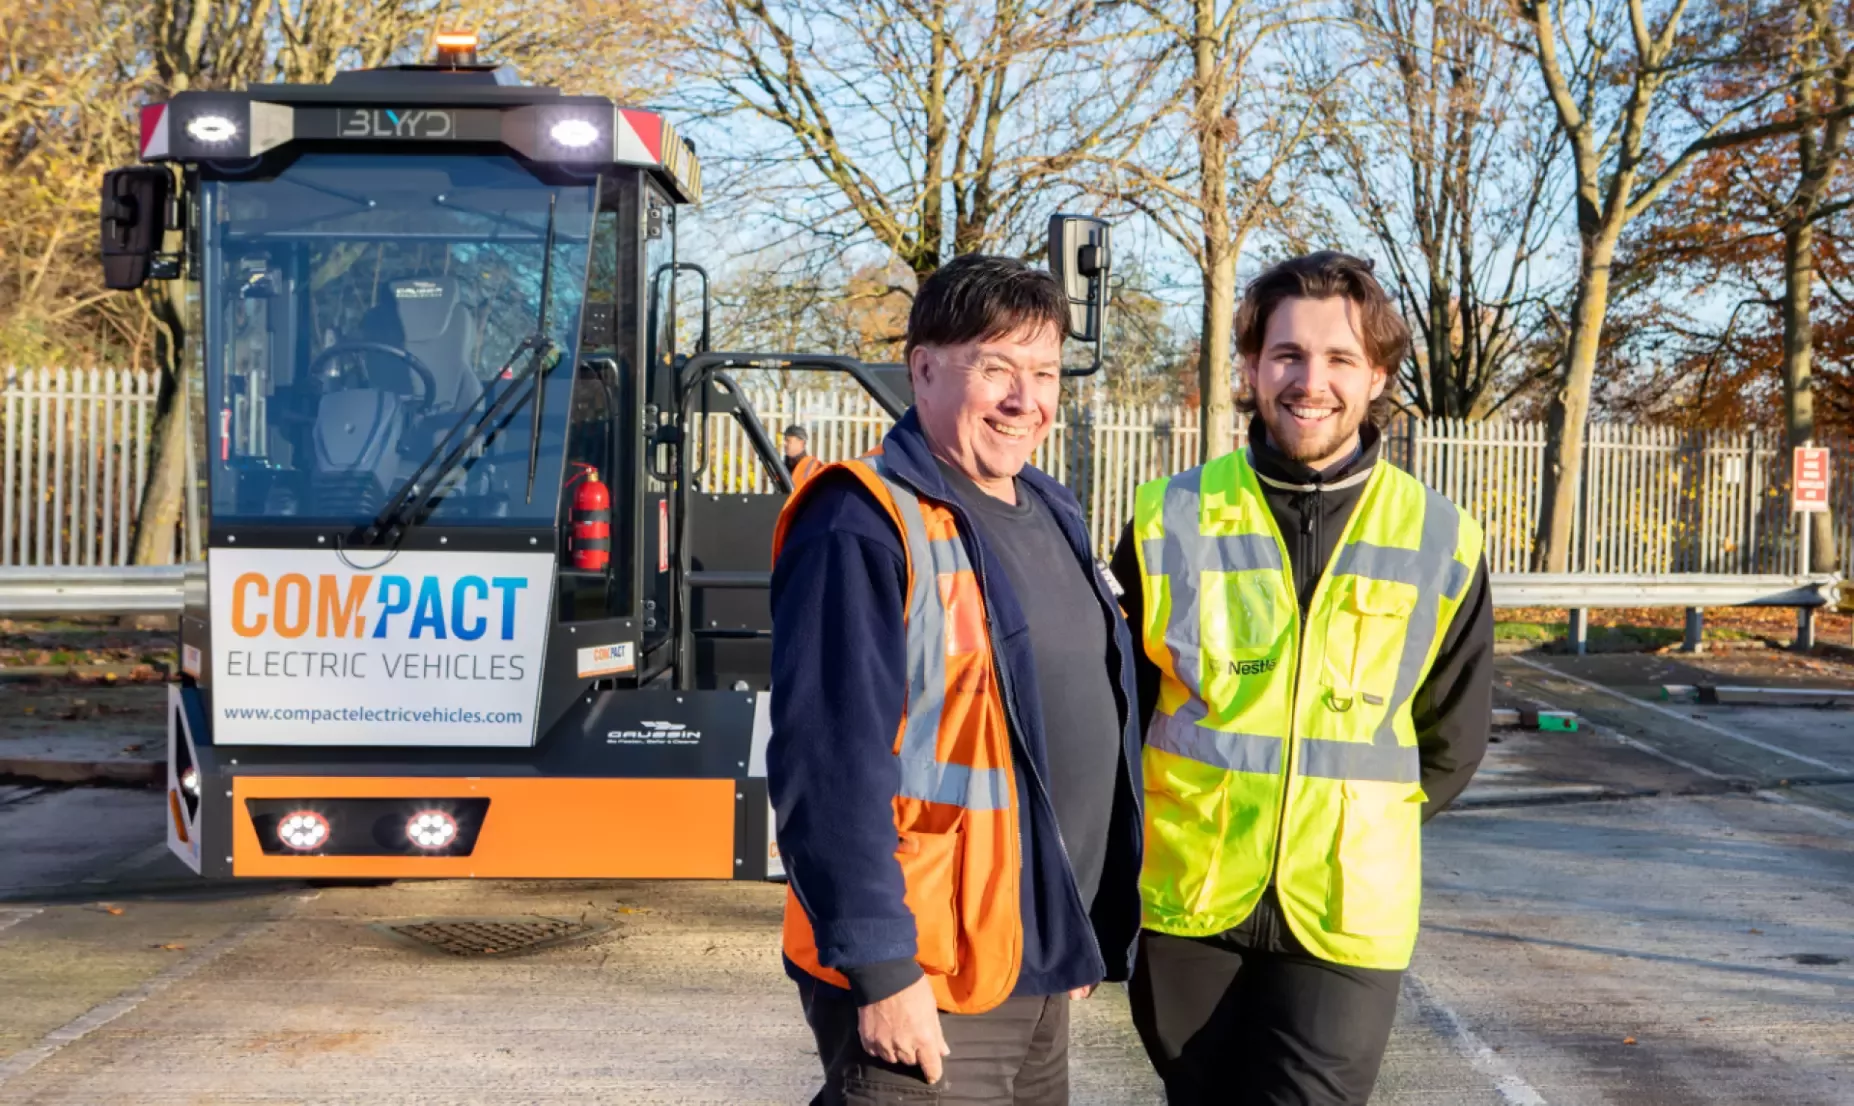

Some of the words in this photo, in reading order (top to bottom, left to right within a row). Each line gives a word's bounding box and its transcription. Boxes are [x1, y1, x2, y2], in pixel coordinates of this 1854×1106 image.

[231, 572, 529, 641] COMPACT
[226, 650, 368, 679] ELECTRIC
[381, 653, 526, 681] VEHICLES
[223, 706, 524, 725] www.compactelectricvehicles.com
